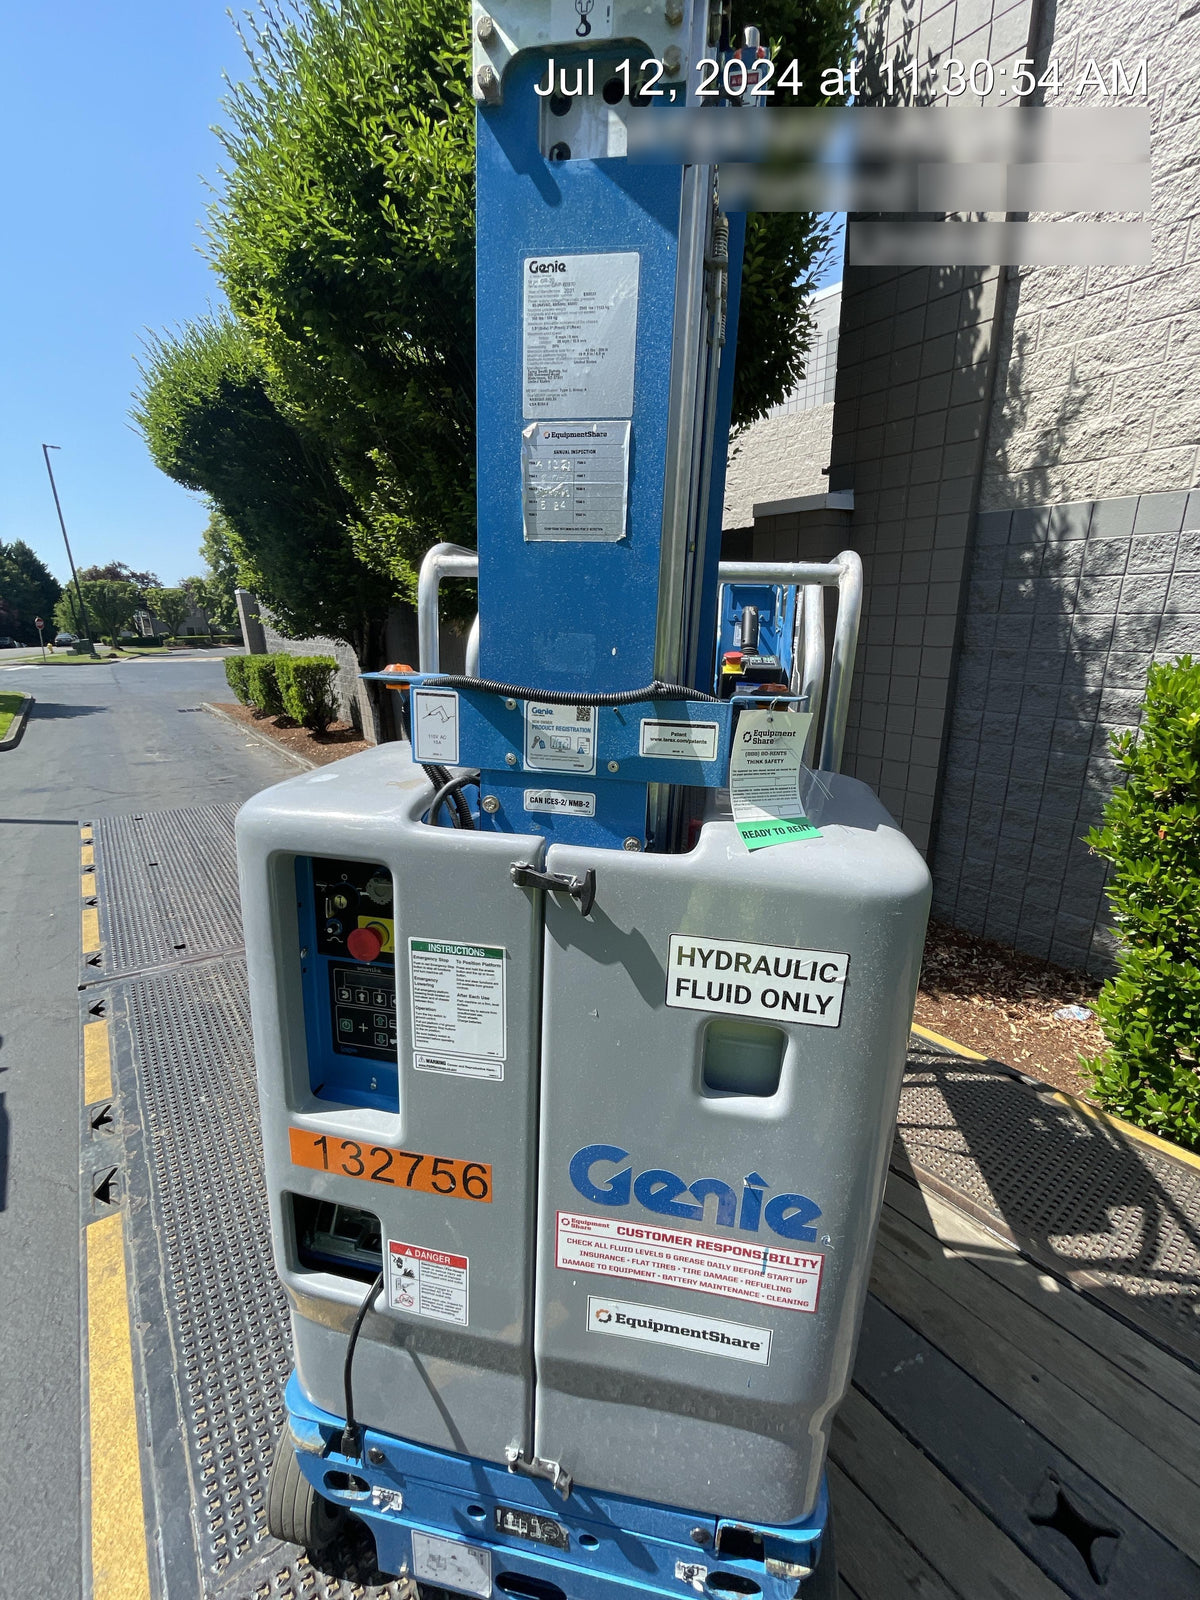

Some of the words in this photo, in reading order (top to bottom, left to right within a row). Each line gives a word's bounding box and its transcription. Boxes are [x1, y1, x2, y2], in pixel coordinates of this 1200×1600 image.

[529, 260, 566, 274] Genie
[552, 431, 608, 439] EquipmentShare
[532, 706, 553, 715] Genie
[569, 800, 590, 808] NMB-2
[742, 828, 772, 839] READY
[773, 827, 786, 836] TO
[788, 823, 811, 834] RENT
[428, 943, 485, 957] INSTRUCTIONS
[677, 945, 839, 984] HYDRAULIC
[676, 977, 752, 1004] FLUID
[760, 988, 835, 1015] ONLY
[314, 1136, 488, 1200] 132756
[569, 1144, 822, 1243] Genie
[571, 1218, 610, 1228] Equipment
[415, 1249, 450, 1264] DANGER
[566, 1238, 592, 1247] CHECK
[610, 1244, 633, 1253] FLUID
[635, 1249, 663, 1258] LEVELS
[673, 1255, 704, 1265] GREASE
[707, 1260, 732, 1271] DAILY
[733, 1265, 765, 1277] BEFORE
[767, 1273, 794, 1283] START
[617, 1226, 692, 1247] CUSTOMER
[696, 1240, 818, 1269] RESPONSIBILITY
[562, 1258, 595, 1268] DAMAGE
[609, 1265, 656, 1278] EQUIPMENT
[662, 1274, 697, 1285] BATTERY
[700, 1281, 760, 1298] MAINTENANCE
[766, 1294, 809, 1307] CLEANING
[580, 1250, 626, 1262] INSURANCE
[652, 1262, 675, 1271] TIRES
[682, 1267, 701, 1275] TIRE
[703, 1271, 738, 1283] DAMAGE
[745, 1280, 792, 1293] REFUELING
[615, 1313, 762, 1351] EquipmentShare
